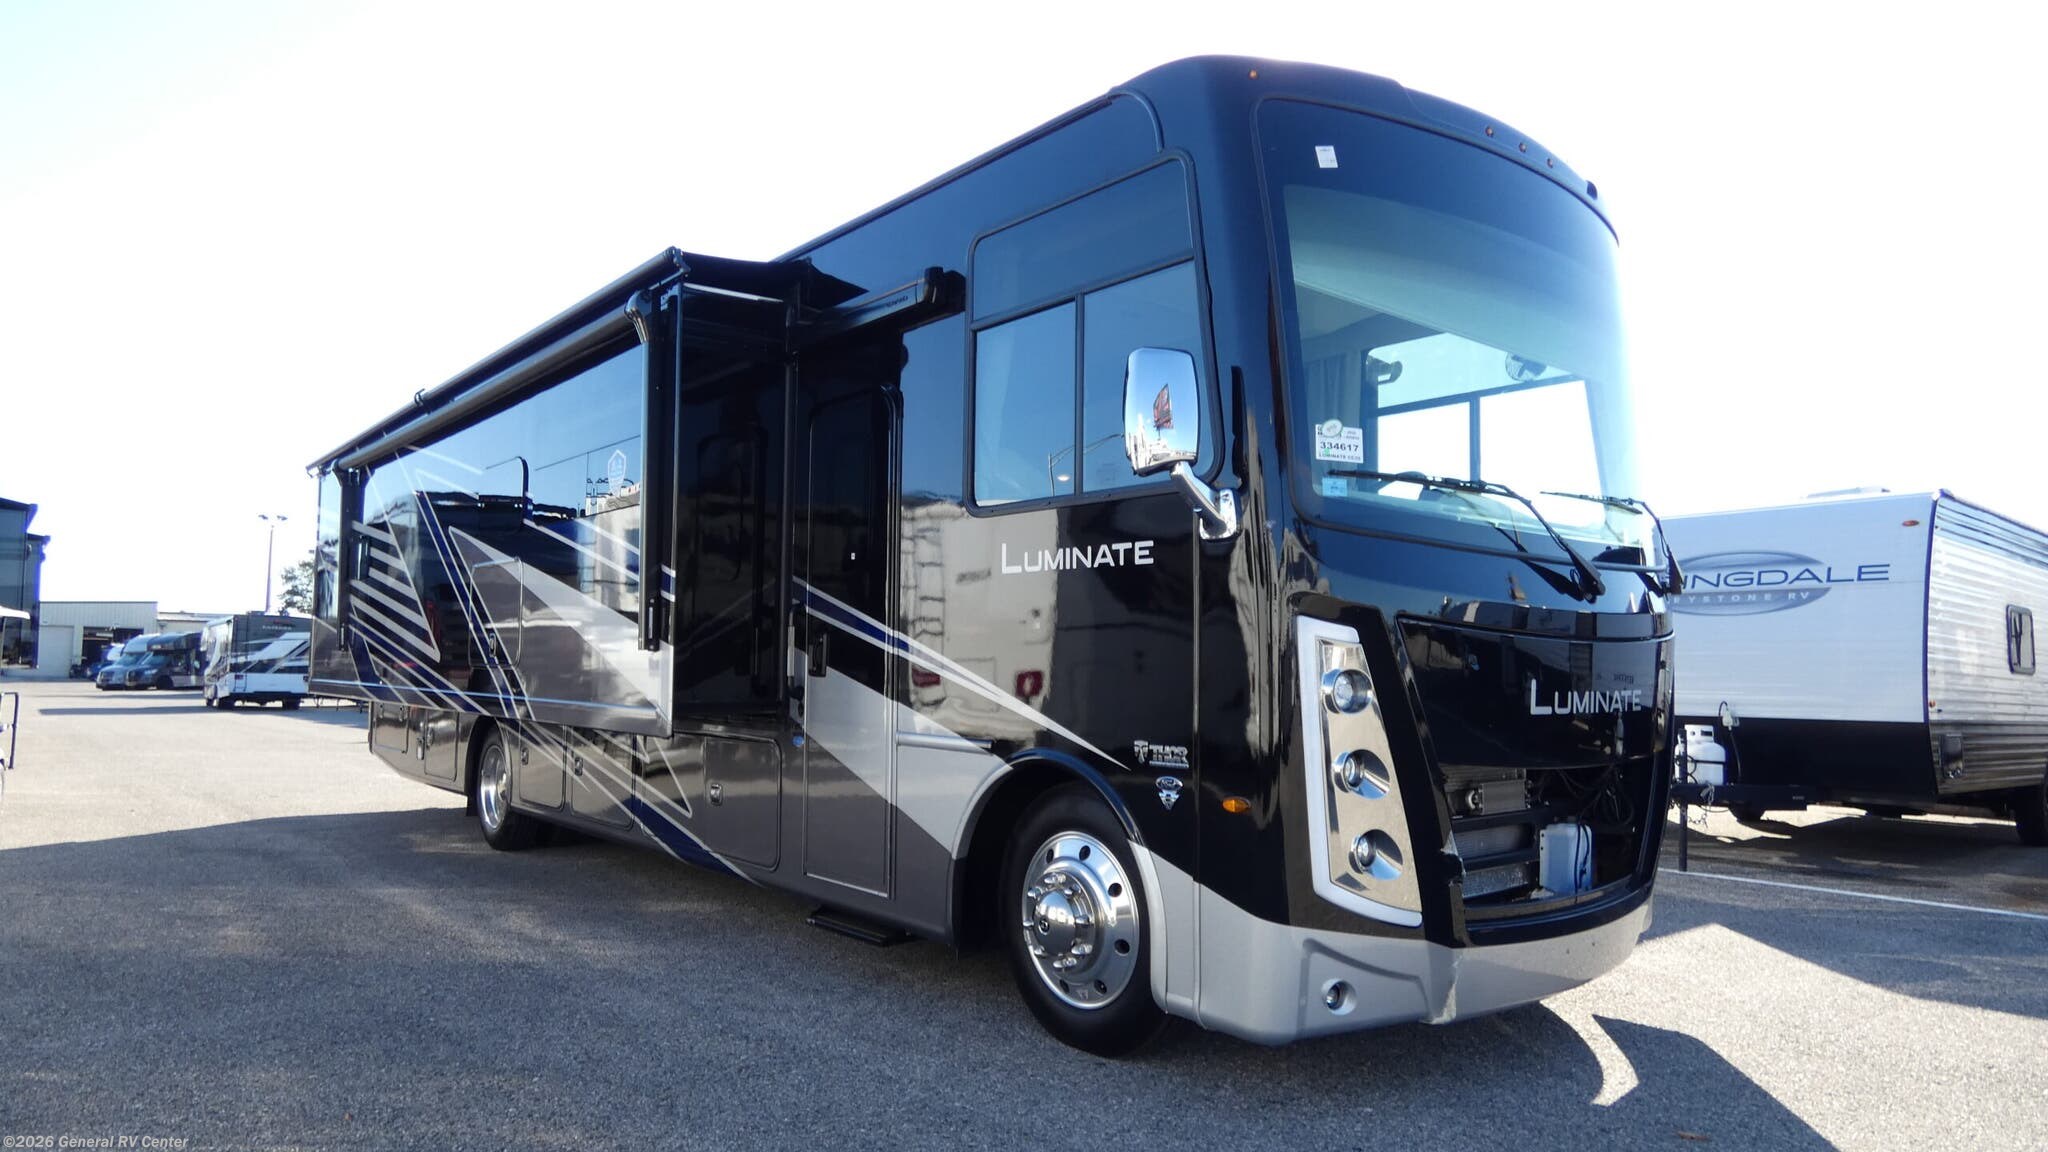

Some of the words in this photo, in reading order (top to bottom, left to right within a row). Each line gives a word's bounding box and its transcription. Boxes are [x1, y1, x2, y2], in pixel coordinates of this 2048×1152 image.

[1319, 441, 1359, 452] 334617
[1001, 540, 1155, 575] LUMINATE
[1683, 564, 1890, 590] INGDALE
[1788, 591, 1810, 601] RV
[1530, 678, 1642, 715] LUMINATE
[1149, 744, 1189, 763] THOR
